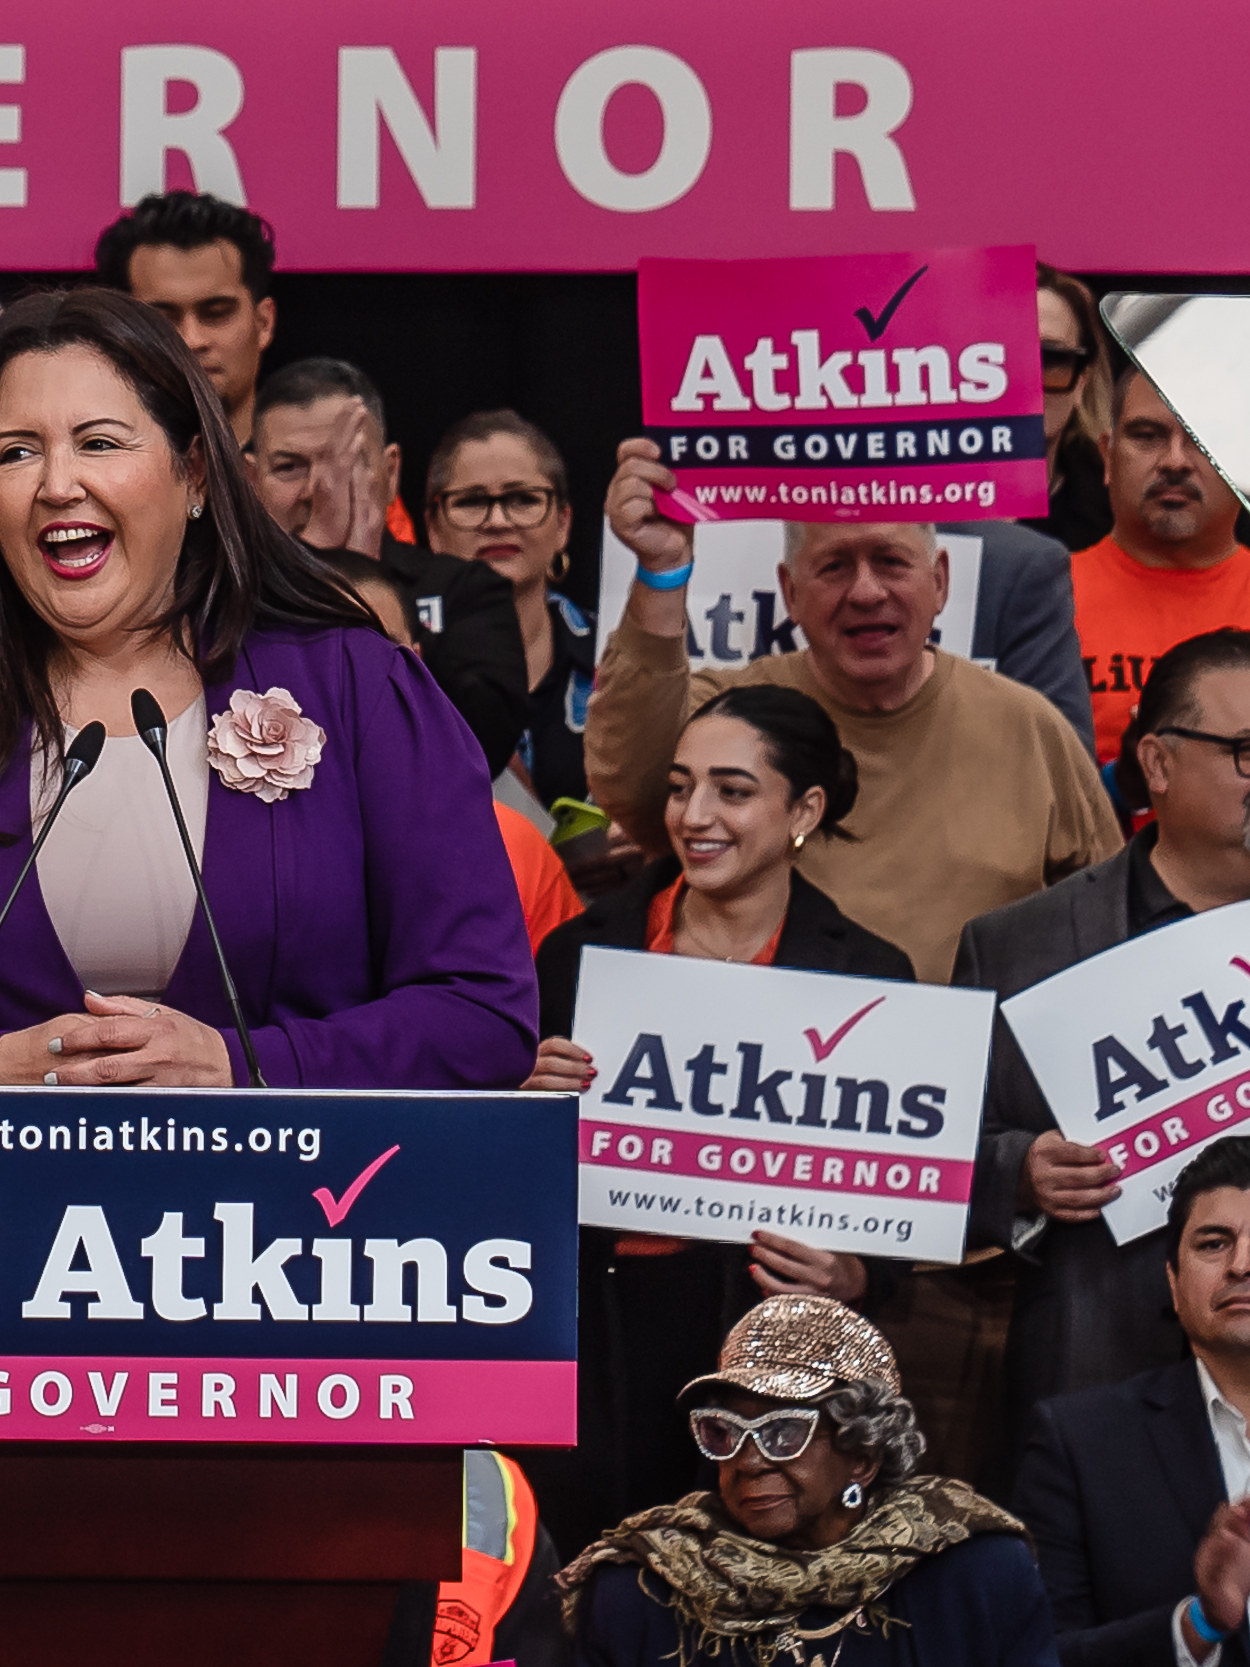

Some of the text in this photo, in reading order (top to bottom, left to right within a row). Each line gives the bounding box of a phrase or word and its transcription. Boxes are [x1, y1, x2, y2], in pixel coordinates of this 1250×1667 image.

[670, 328, 1009, 413] Atkins
[670, 426, 1013, 461] FOR GOVERNOR
[694, 480, 997, 508] www.toniatkins.org
[601, 1033, 948, 1139] Atkins
[591, 1130, 941, 1193] FOR GOVERNOR
[1108, 1116, 1190, 1171] FOR
[608, 1189, 914, 1242] www.toniatkins.org
[22, 1201, 534, 1325] Atkins
